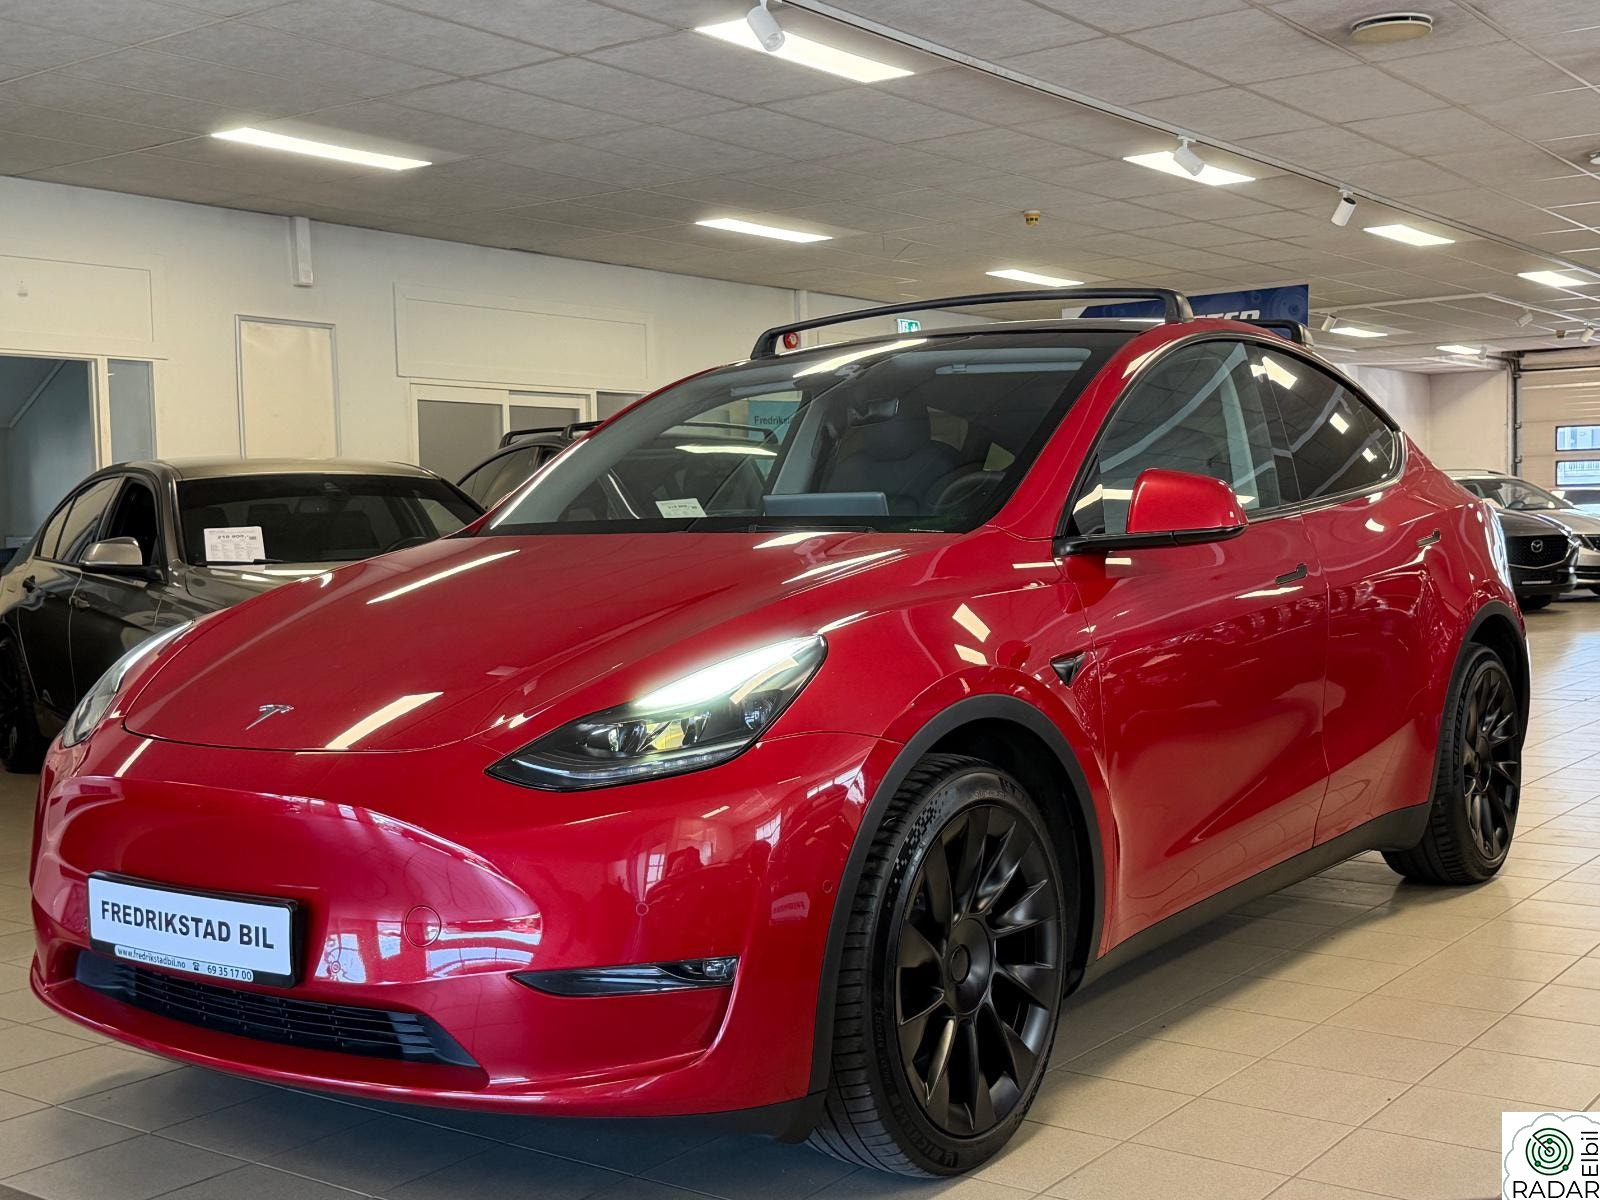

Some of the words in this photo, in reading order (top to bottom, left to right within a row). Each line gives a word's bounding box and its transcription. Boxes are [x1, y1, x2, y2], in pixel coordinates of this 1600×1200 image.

[101, 899, 231, 942] FREDRIKSTAD
[239, 923, 274, 949] BIL
[117, 949, 186, 969] www.fredrikstadbil.no
[207, 964, 217, 975] 69
[219, 966, 228, 977] 35
[230, 968, 240, 978] 17
[241, 970, 252, 981] 00
